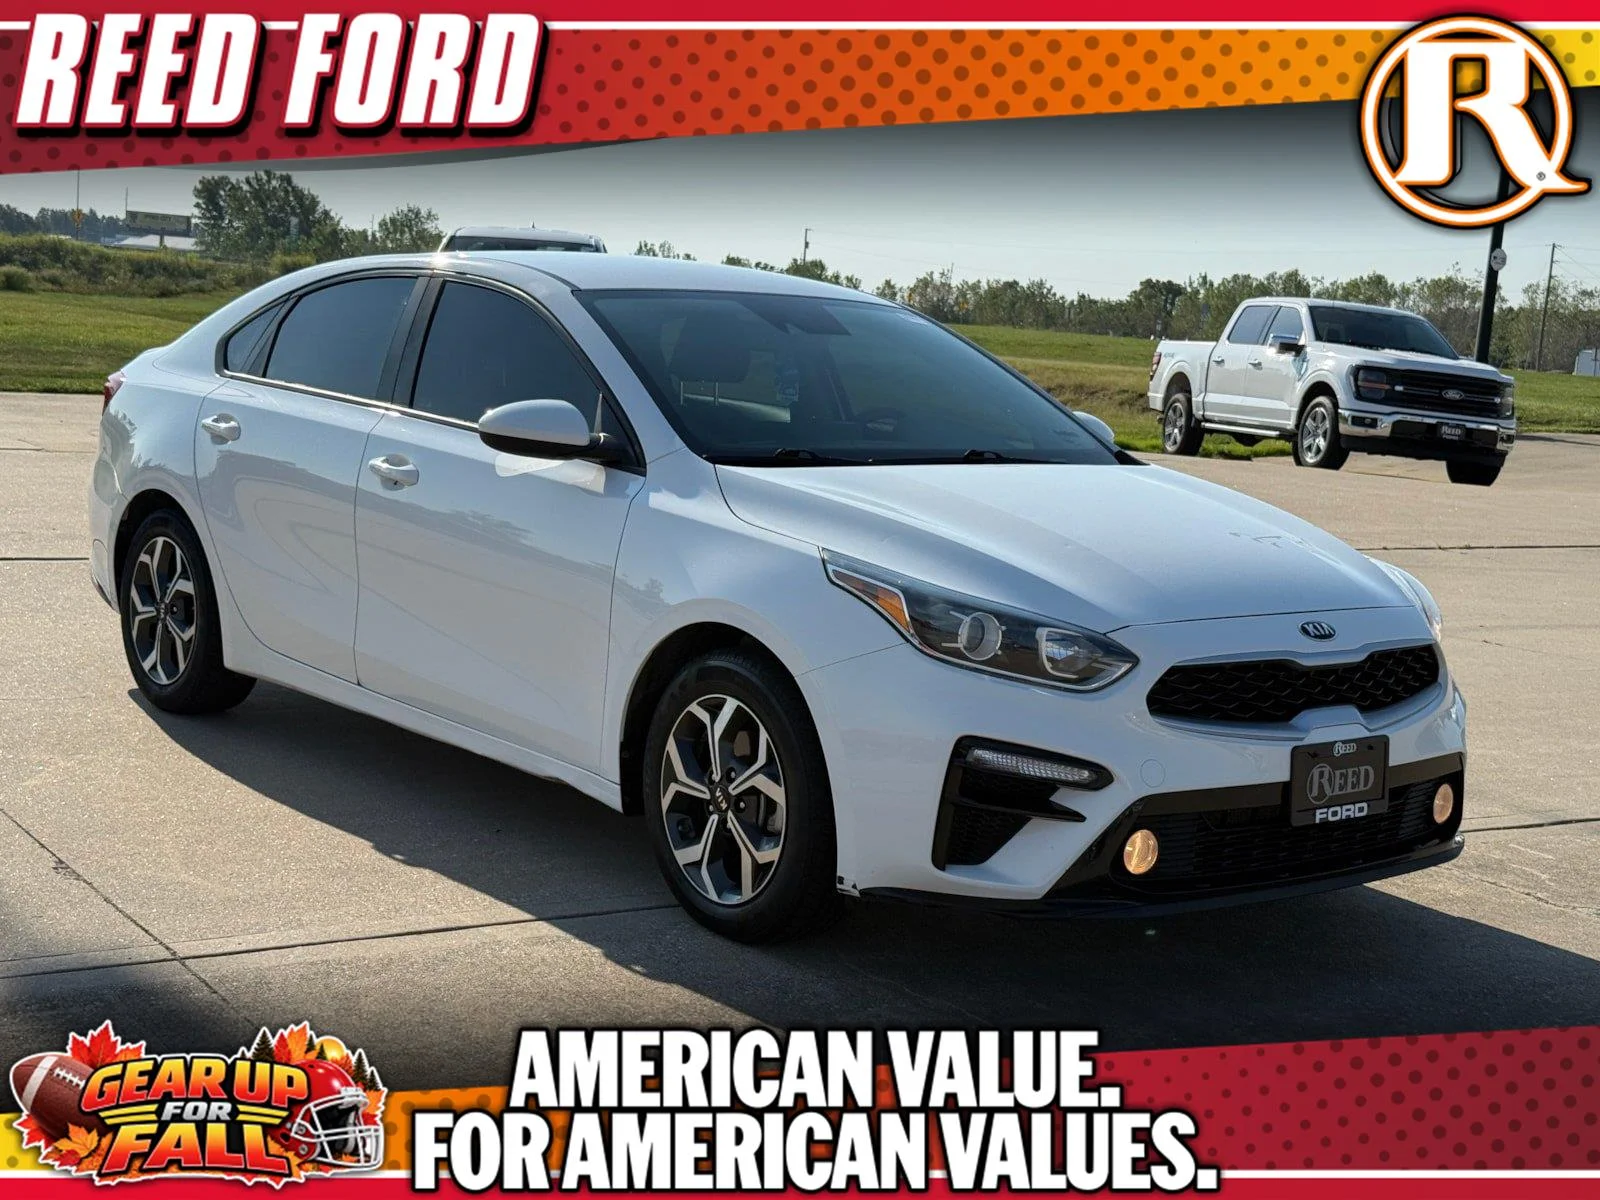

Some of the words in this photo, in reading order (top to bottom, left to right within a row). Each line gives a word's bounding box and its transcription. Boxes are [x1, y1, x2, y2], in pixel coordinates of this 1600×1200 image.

[1302, 622, 1335, 637] KIA
[1333, 741, 1357, 757] REED
[1307, 763, 1375, 804] REED
[1315, 802, 1368, 823] FORD
